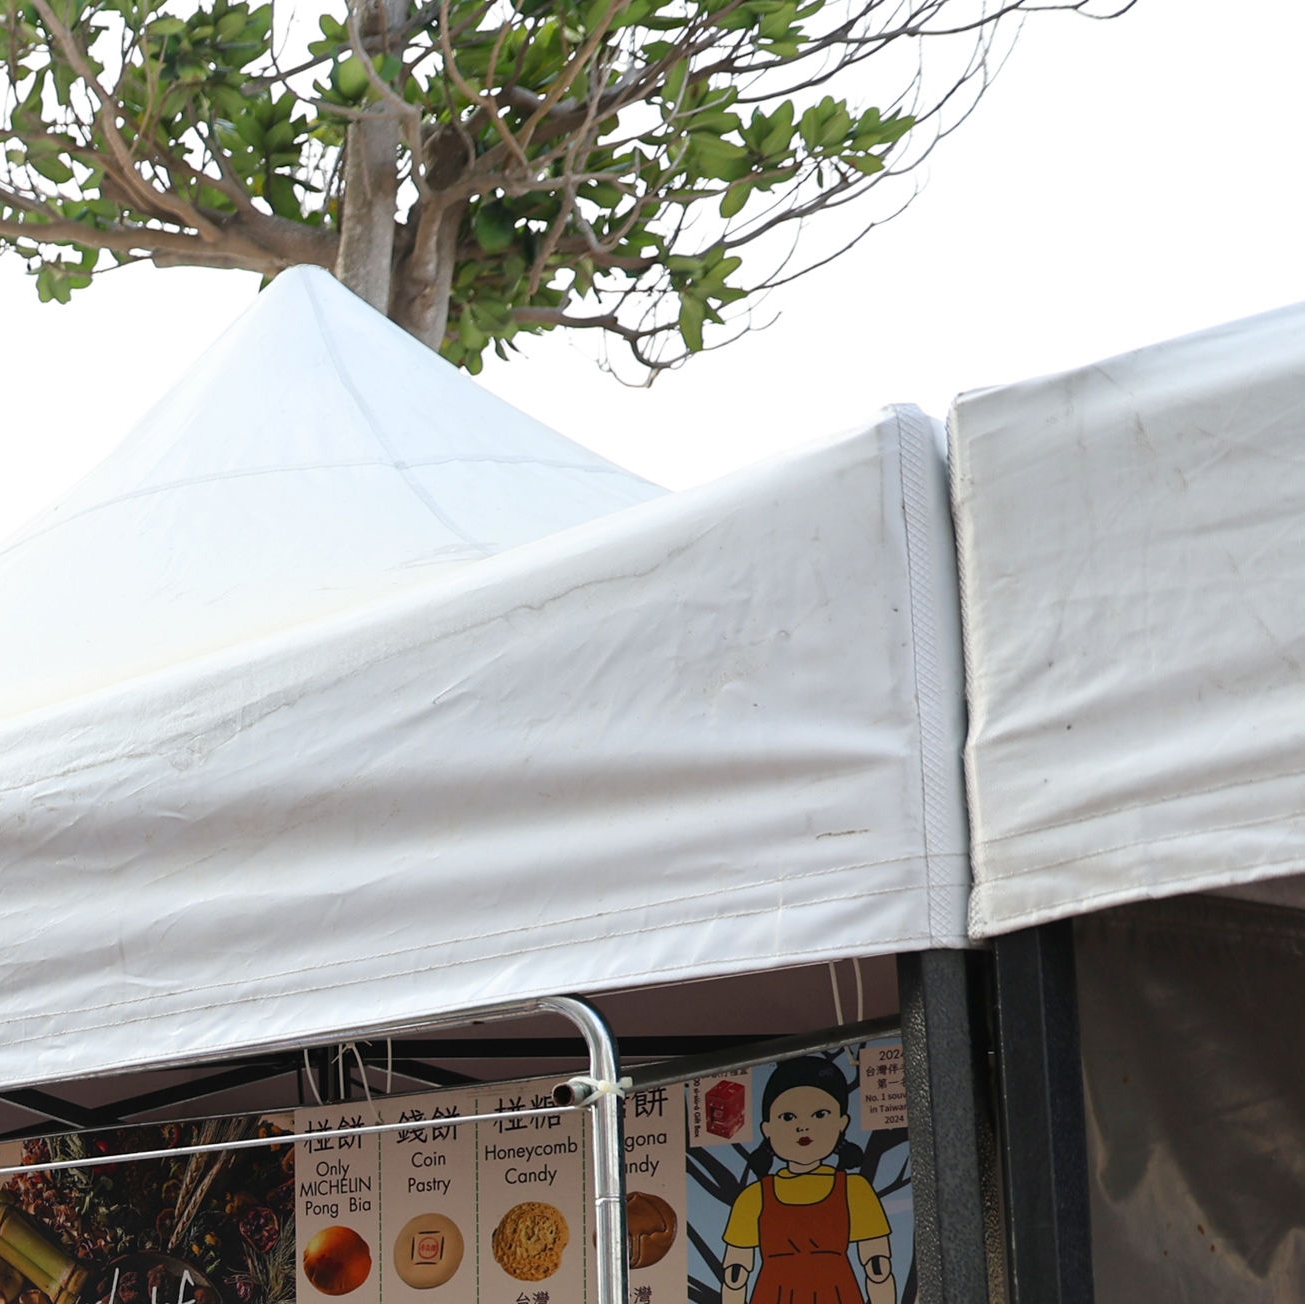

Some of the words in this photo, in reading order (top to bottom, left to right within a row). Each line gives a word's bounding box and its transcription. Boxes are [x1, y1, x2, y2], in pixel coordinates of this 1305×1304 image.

[879, 1049, 903, 1060] 202
[866, 1094, 880, 1102] No.
[869, 1105, 878, 1113] in
[885, 1115, 904, 1124] 2024
[304, 1115, 365, 1153] 椪餅
[396, 1106, 460, 1143] 錢餅
[485, 1136, 578, 1162] Honeycomb
[625, 1132, 667, 1151] gona
[316, 1159, 350, 1180] Only
[411, 1151, 446, 1168] Coin
[625, 1154, 659, 1177] ndy
[504, 1164, 557, 1186] Candy
[300, 1176, 372, 1197] MICHELIN
[408, 1177, 451, 1195] Pastry
[305, 1200, 339, 1218] Pong
[349, 1197, 371, 1212] Bia
